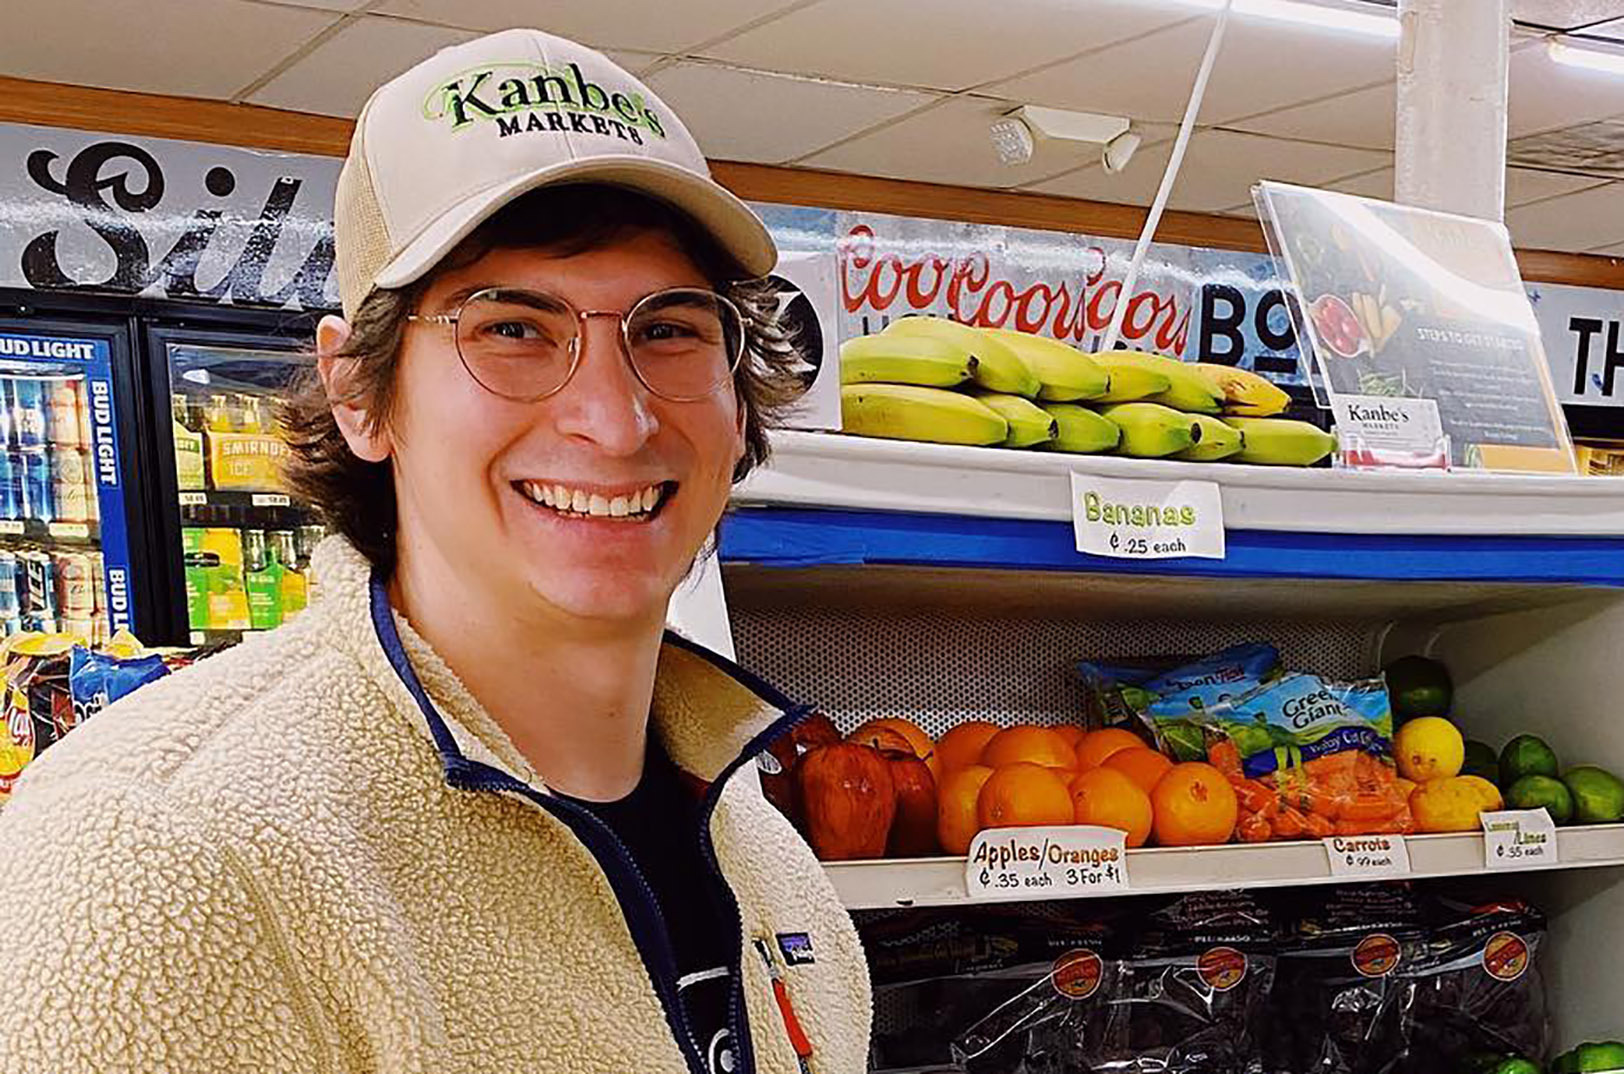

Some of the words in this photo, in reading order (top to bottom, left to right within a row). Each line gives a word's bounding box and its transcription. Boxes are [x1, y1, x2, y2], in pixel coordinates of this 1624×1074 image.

[496, 111, 643, 146] MARKETS
[20, 140, 342, 308] Sil
[0, 338, 30, 355] UD
[31, 340, 94, 359] LIGHT
[92, 381, 110, 424] BUD
[1347, 404, 1410, 423] Kanbe's
[96, 426, 117, 486] LIGHT
[1084, 491, 1197, 527] Bananas
[1153, 537, 1187, 553] each
[109, 569, 127, 611] BUD
[1333, 837, 1391, 852] Carrots
[1024, 872, 1053, 887] each
